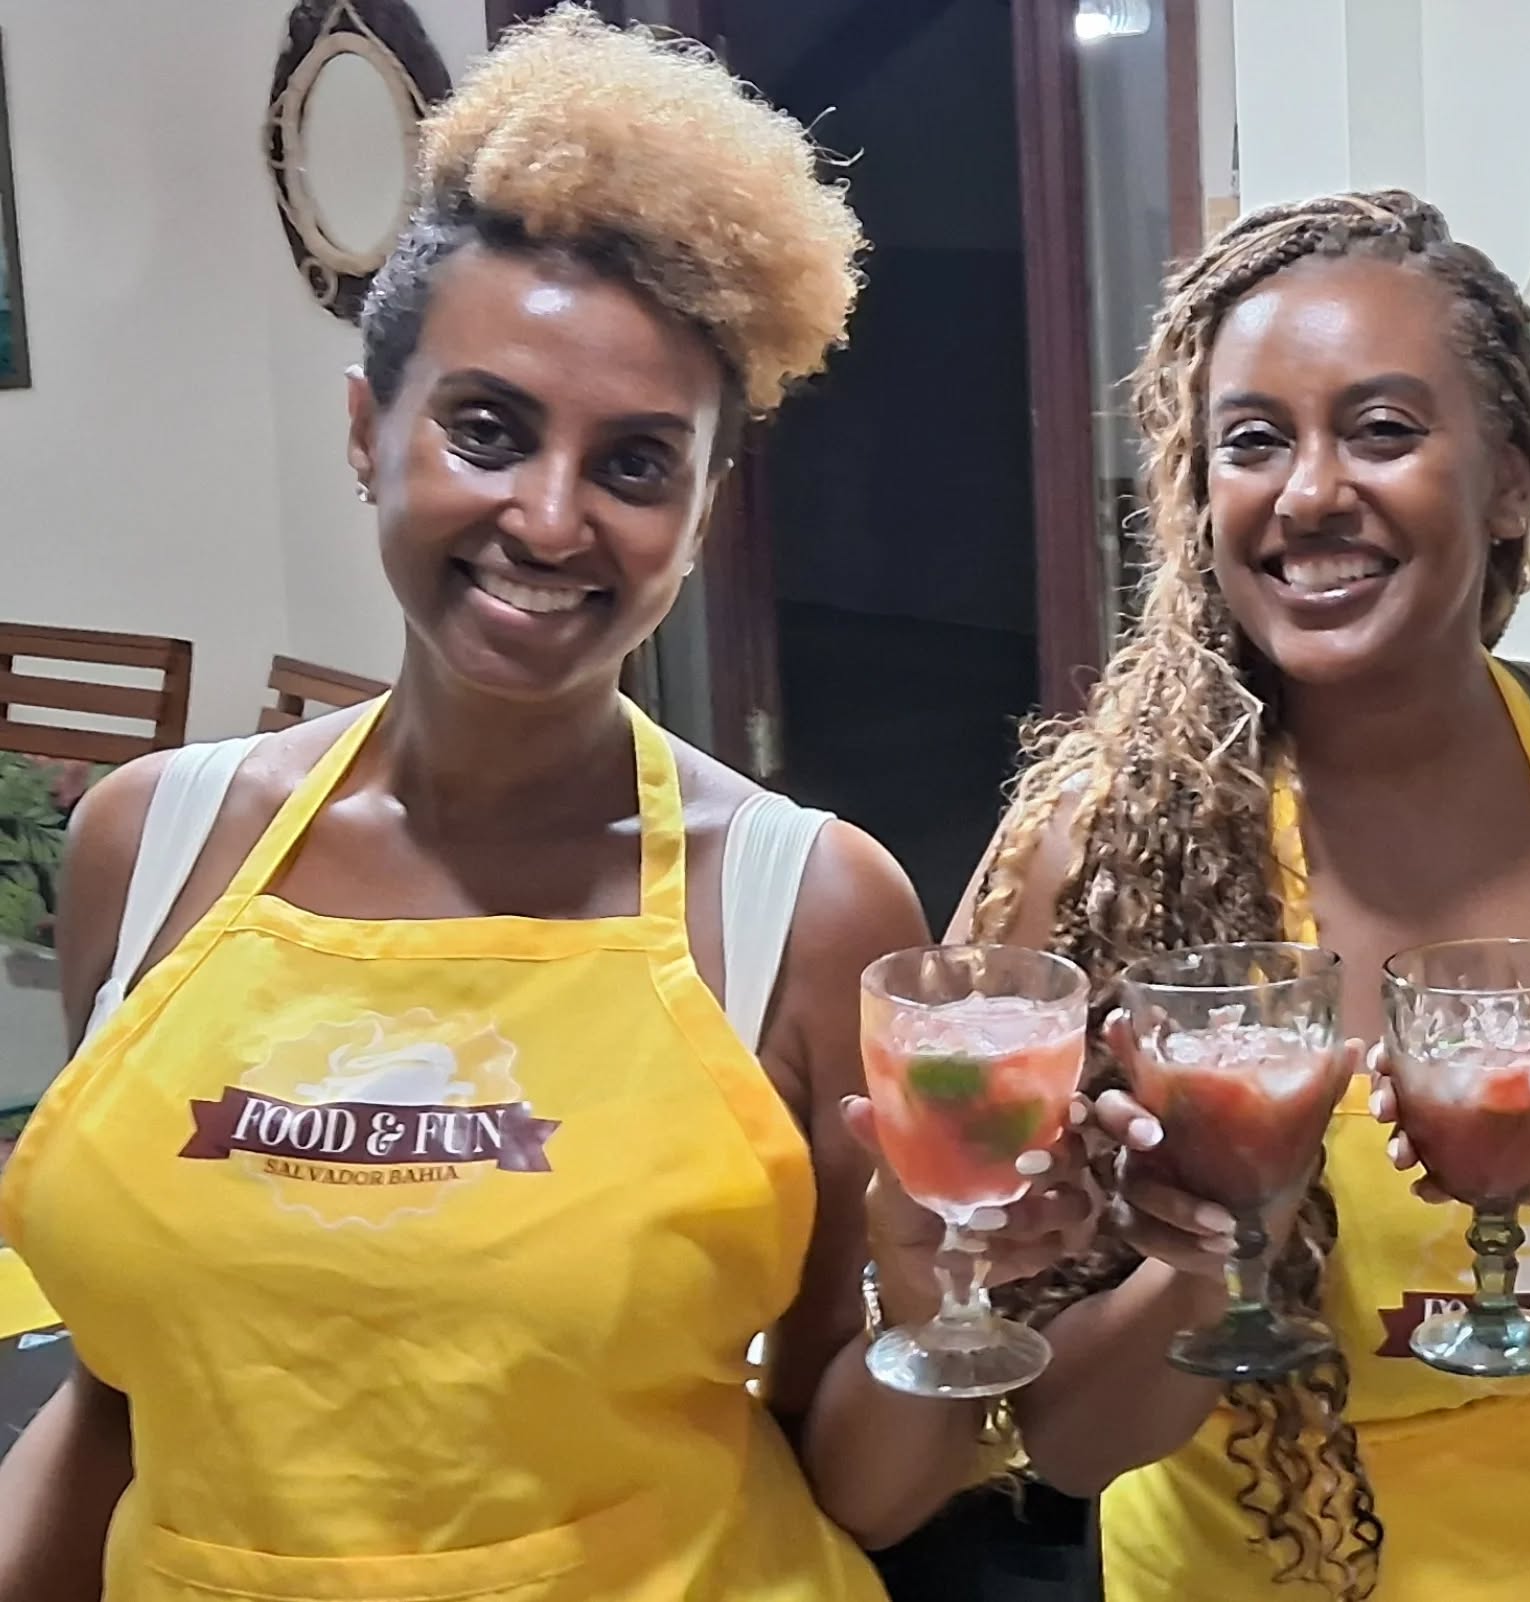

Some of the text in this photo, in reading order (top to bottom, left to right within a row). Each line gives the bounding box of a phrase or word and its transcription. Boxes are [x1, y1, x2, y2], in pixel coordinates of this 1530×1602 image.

[232, 1097, 505, 1156] FOOD & FUN
[263, 1158, 460, 1186] SALVADOR BAHIA
